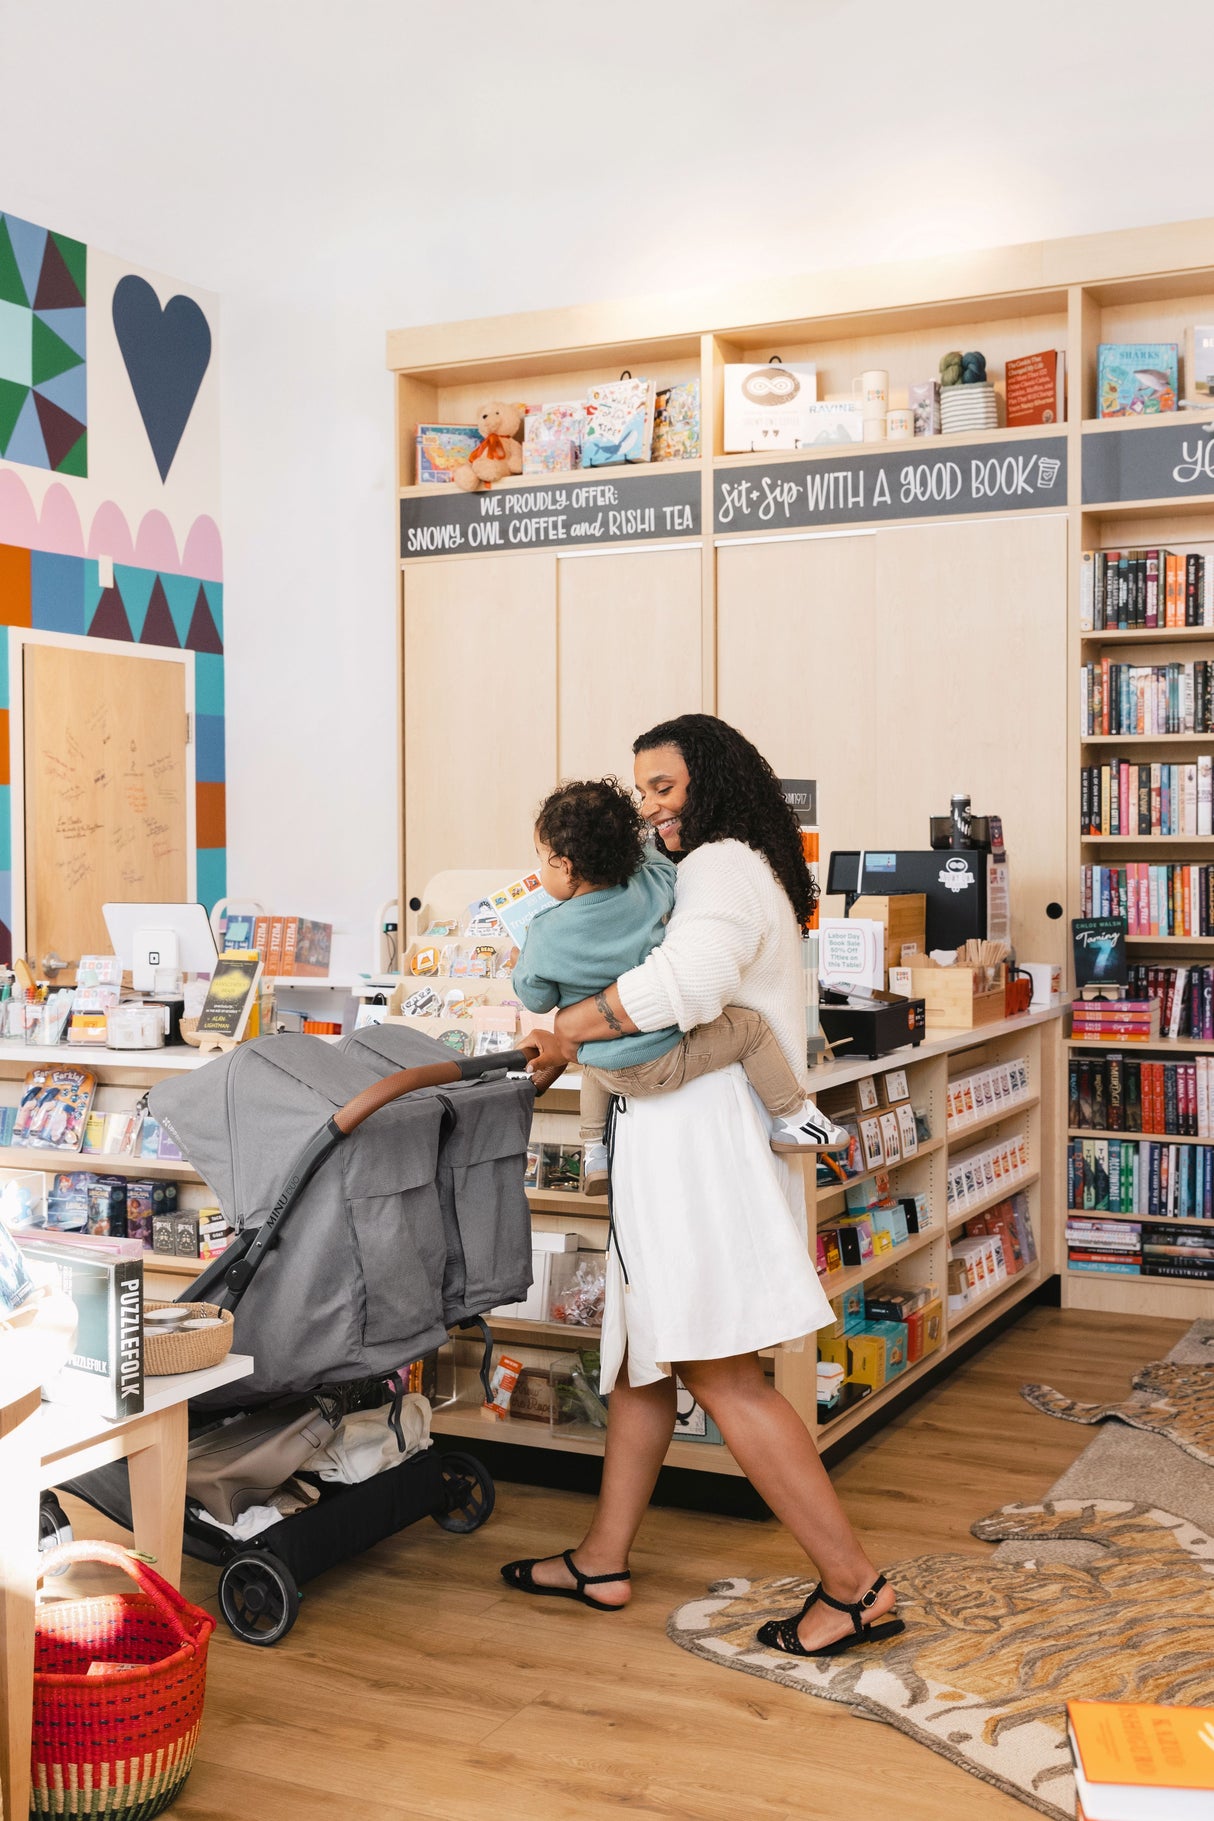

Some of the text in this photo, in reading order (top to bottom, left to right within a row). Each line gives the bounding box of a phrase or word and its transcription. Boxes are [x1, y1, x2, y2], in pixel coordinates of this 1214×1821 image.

[1119, 351, 1160, 360] SHARKS
[809, 403, 855, 414] RAVINE
[806, 470, 865, 511] WITH
[872, 468, 892, 507] A
[971, 454, 1038, 499] BOOK
[480, 485, 618, 516] WE PROUDLY OFFER:
[407, 505, 693, 551] SNOWY OWL COFFEE and RISHI TEA
[1075, 930, 1121, 949] Taming
[1099, 920, 1121, 928] WALSH
[1089, 940, 1113, 977] 7
[53, 1071, 85, 1083] Farkle!
[1110, 1066, 1121, 1107] MURTAGH
[285, 1175, 300, 1196] DUO
[1109, 1157, 1120, 1201] ACCOUNTABLE
[266, 1193, 289, 1230] MINU
[1158, 1267, 1208, 1277] STEELSTRIKER
[120, 1278, 140, 1399] PUZZLEFOLK
